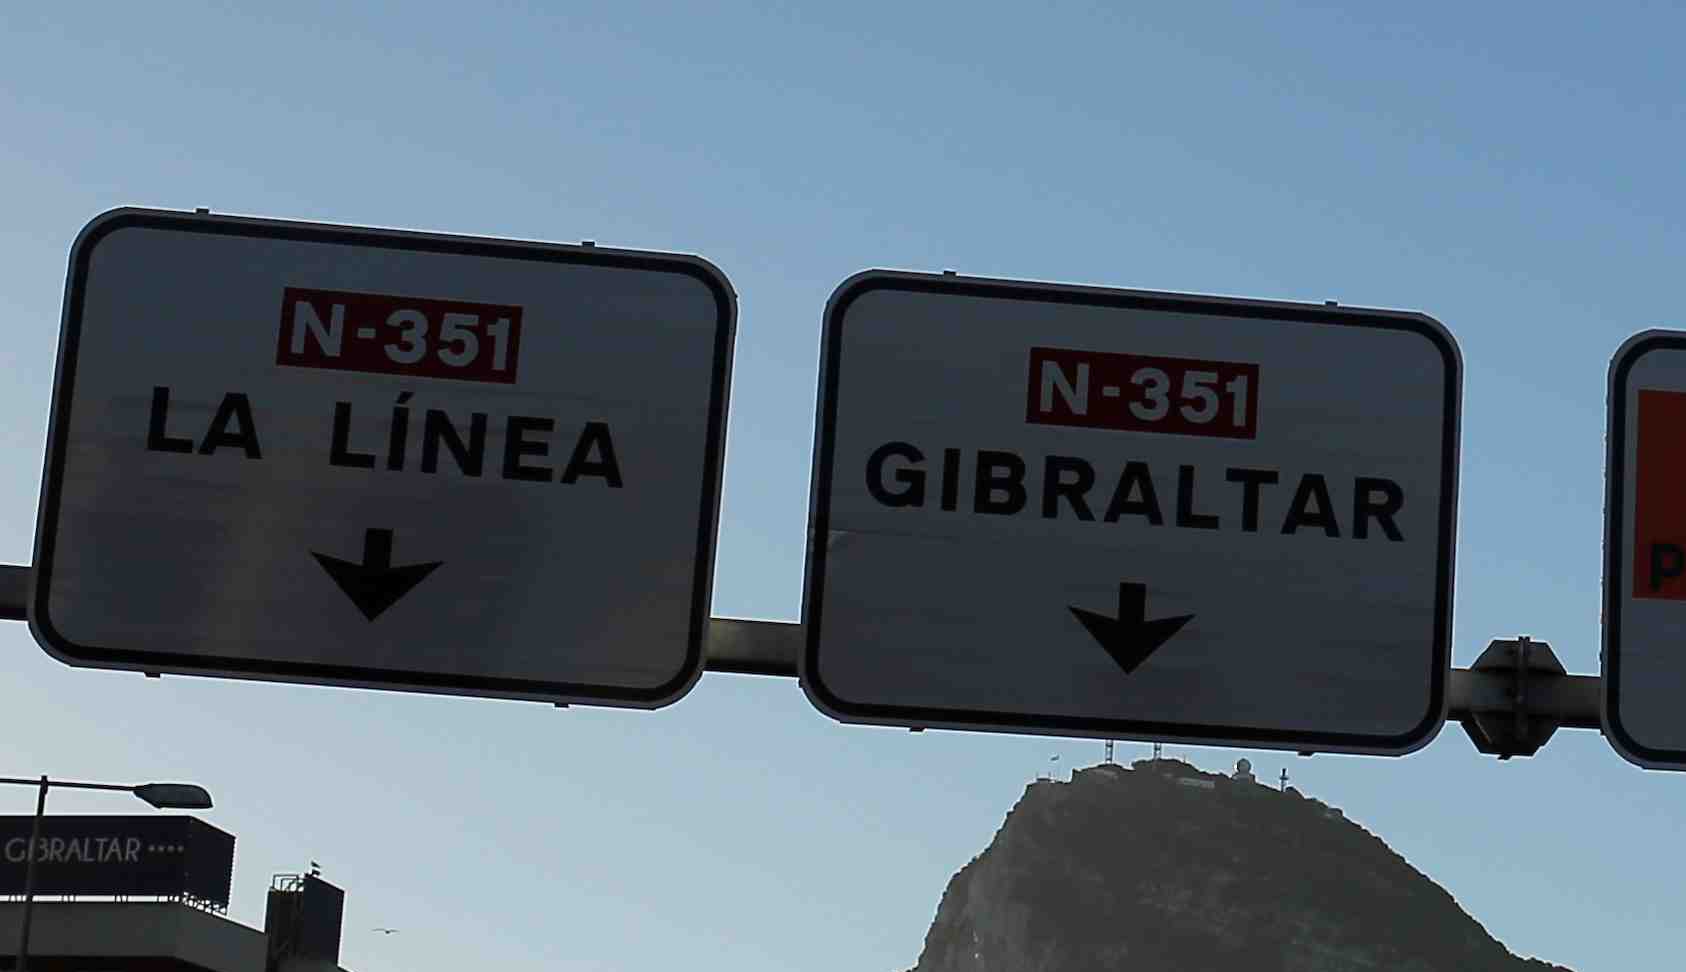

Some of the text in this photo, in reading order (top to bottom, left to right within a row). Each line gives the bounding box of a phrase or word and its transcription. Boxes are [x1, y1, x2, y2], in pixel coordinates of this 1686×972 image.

[289, 299, 514, 372] N-351
[1038, 359, 1249, 428] N-351
[147, 386, 624, 489] LA LÍNEA
[865, 441, 1405, 542] GIBRALTAR
[4, 836, 142, 863] GIBRALTAR
